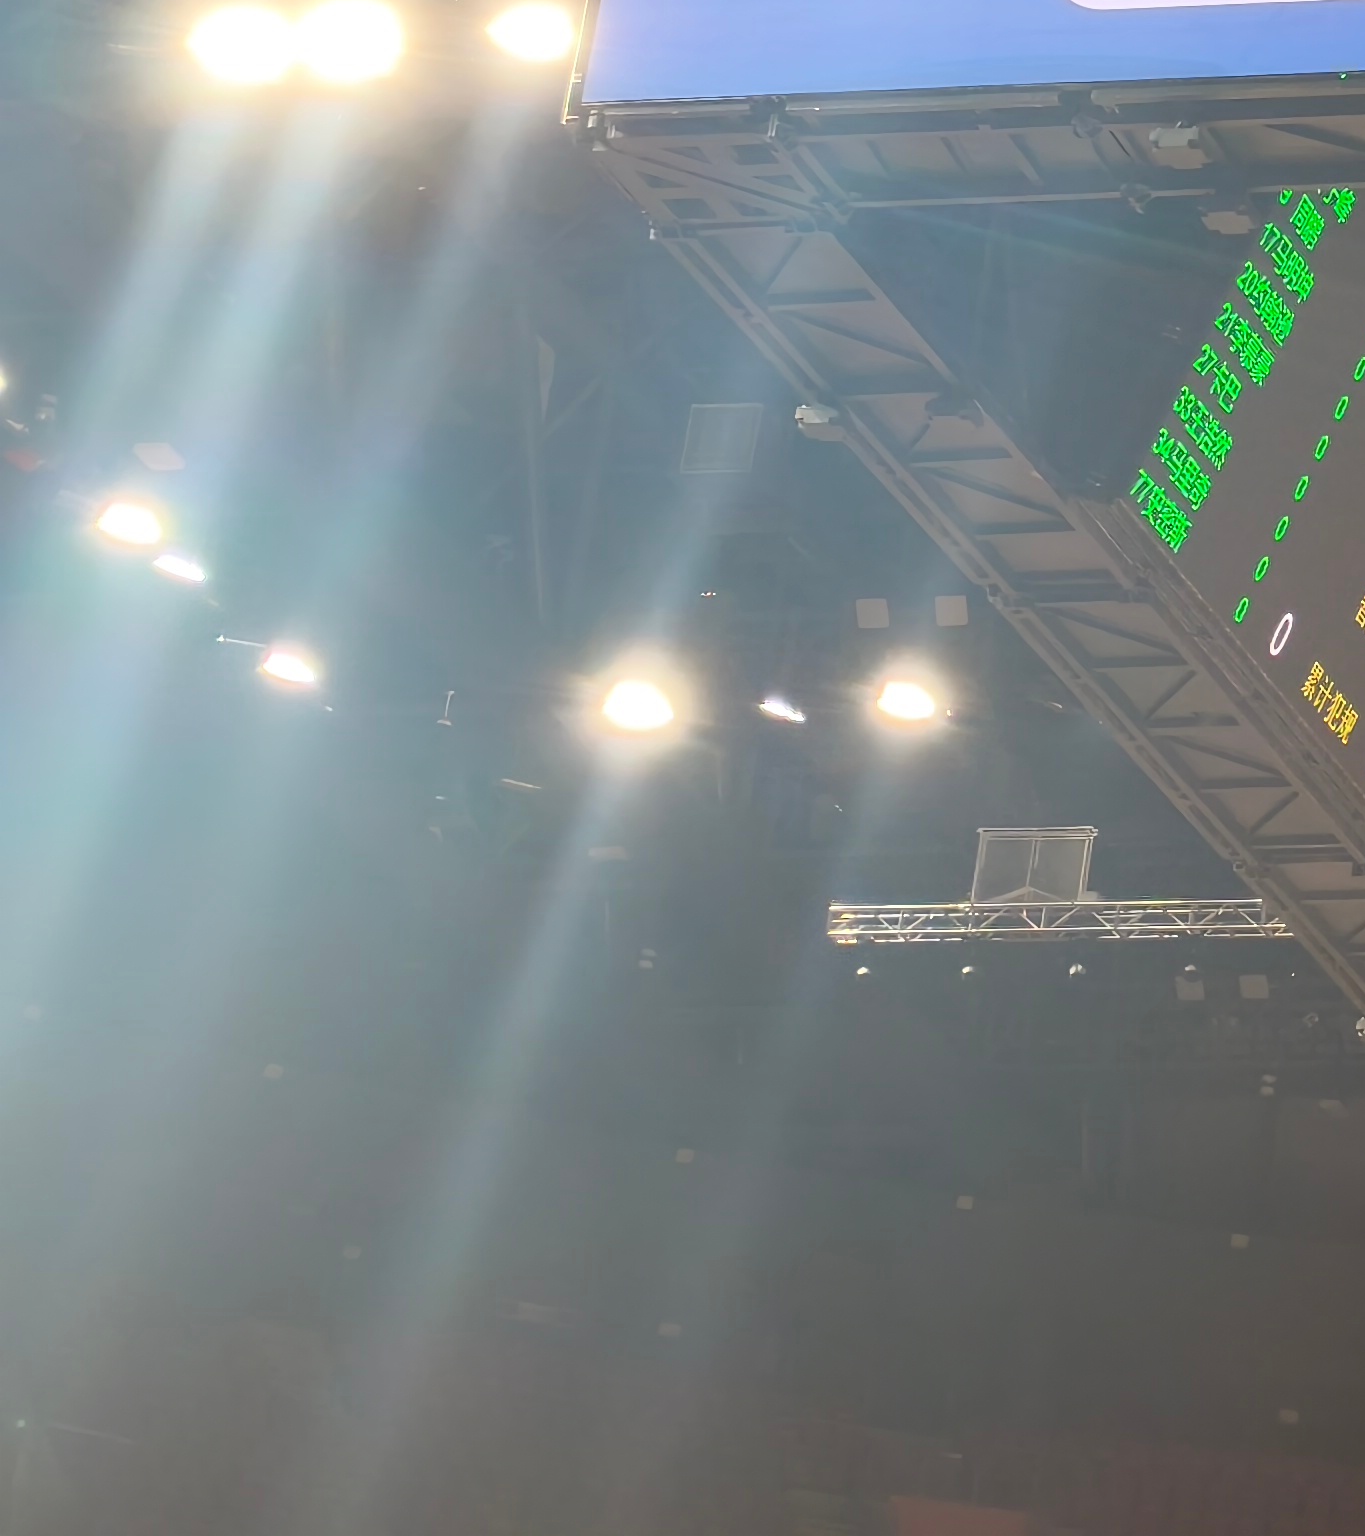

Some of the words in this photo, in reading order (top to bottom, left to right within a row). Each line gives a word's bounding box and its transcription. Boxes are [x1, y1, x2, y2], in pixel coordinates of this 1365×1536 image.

[1333, 395, 1350, 423] 0
[1313, 435, 1331, 463] 0
[1293, 475, 1311, 503] 0
[1273, 515, 1291, 543] 0
[1253, 556, 1271, 584] 0
[1233, 597, 1251, 625] 0
[1269, 612, 1294, 656] 0
[1301, 661, 1359, 745] 累计犯规
